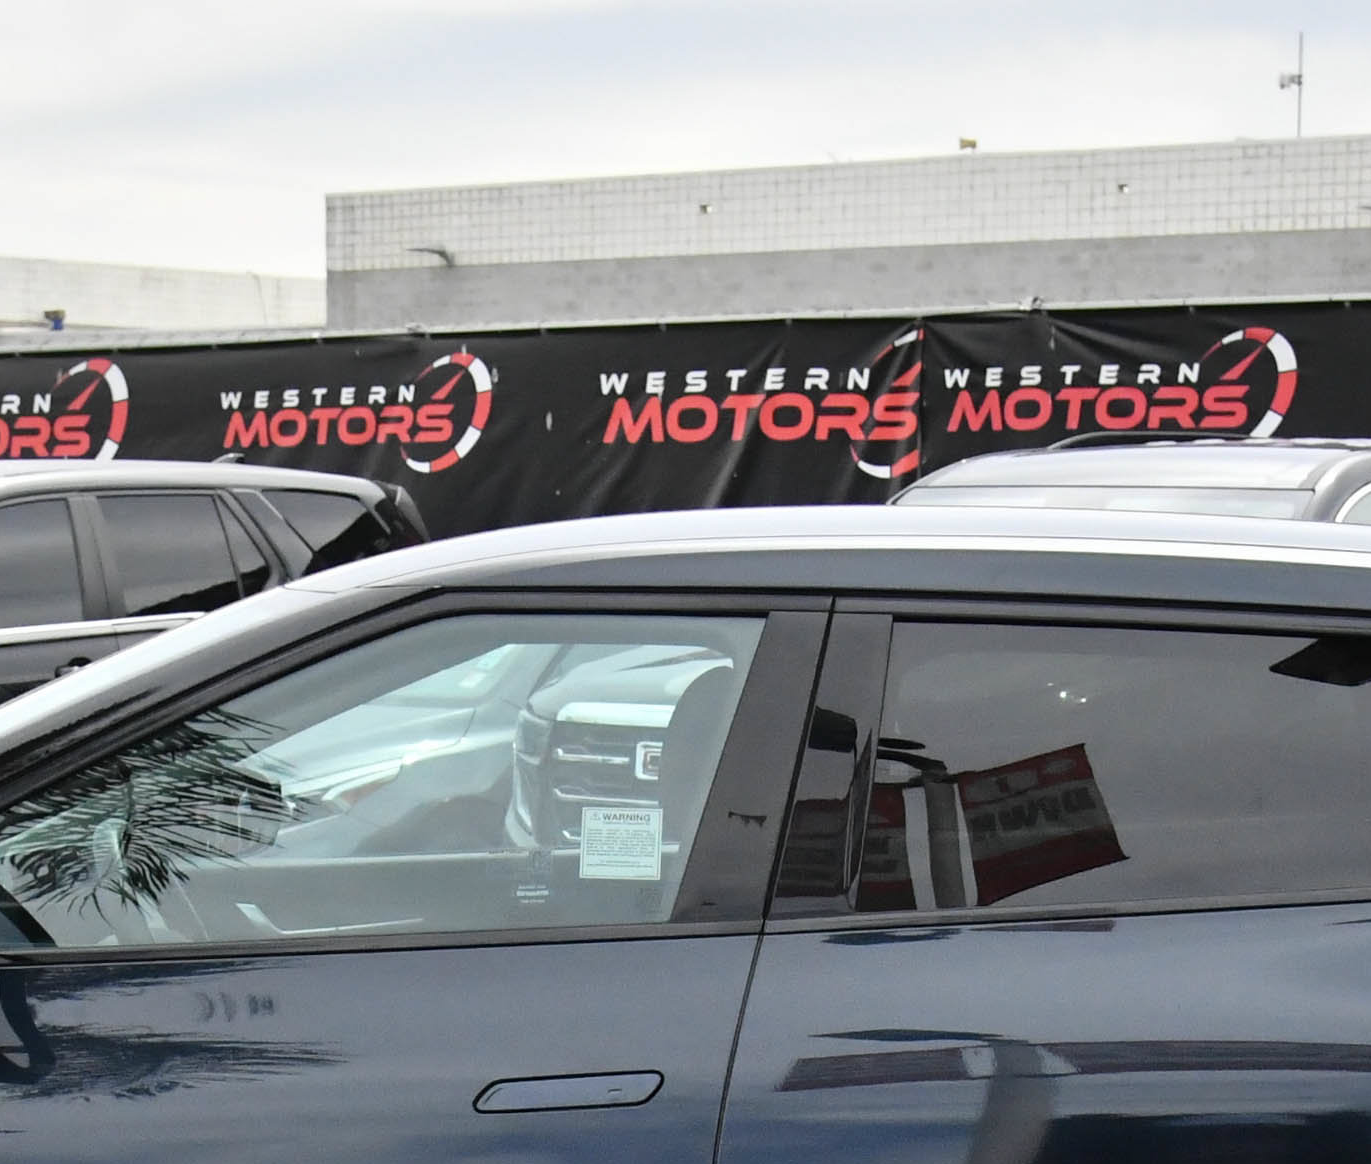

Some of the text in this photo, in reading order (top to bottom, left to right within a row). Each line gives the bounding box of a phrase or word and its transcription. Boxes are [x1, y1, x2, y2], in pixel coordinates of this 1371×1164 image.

[600, 368, 871, 395] WESTERN
[944, 363, 1201, 389] WESTERN
[220, 385, 416, 410] WESTERN
[946, 385, 1250, 432] MOTORS
[223, 403, 455, 449] MOTORS
[602, 392, 920, 444] MOTORS
[602, 812, 651, 822] WARNING
